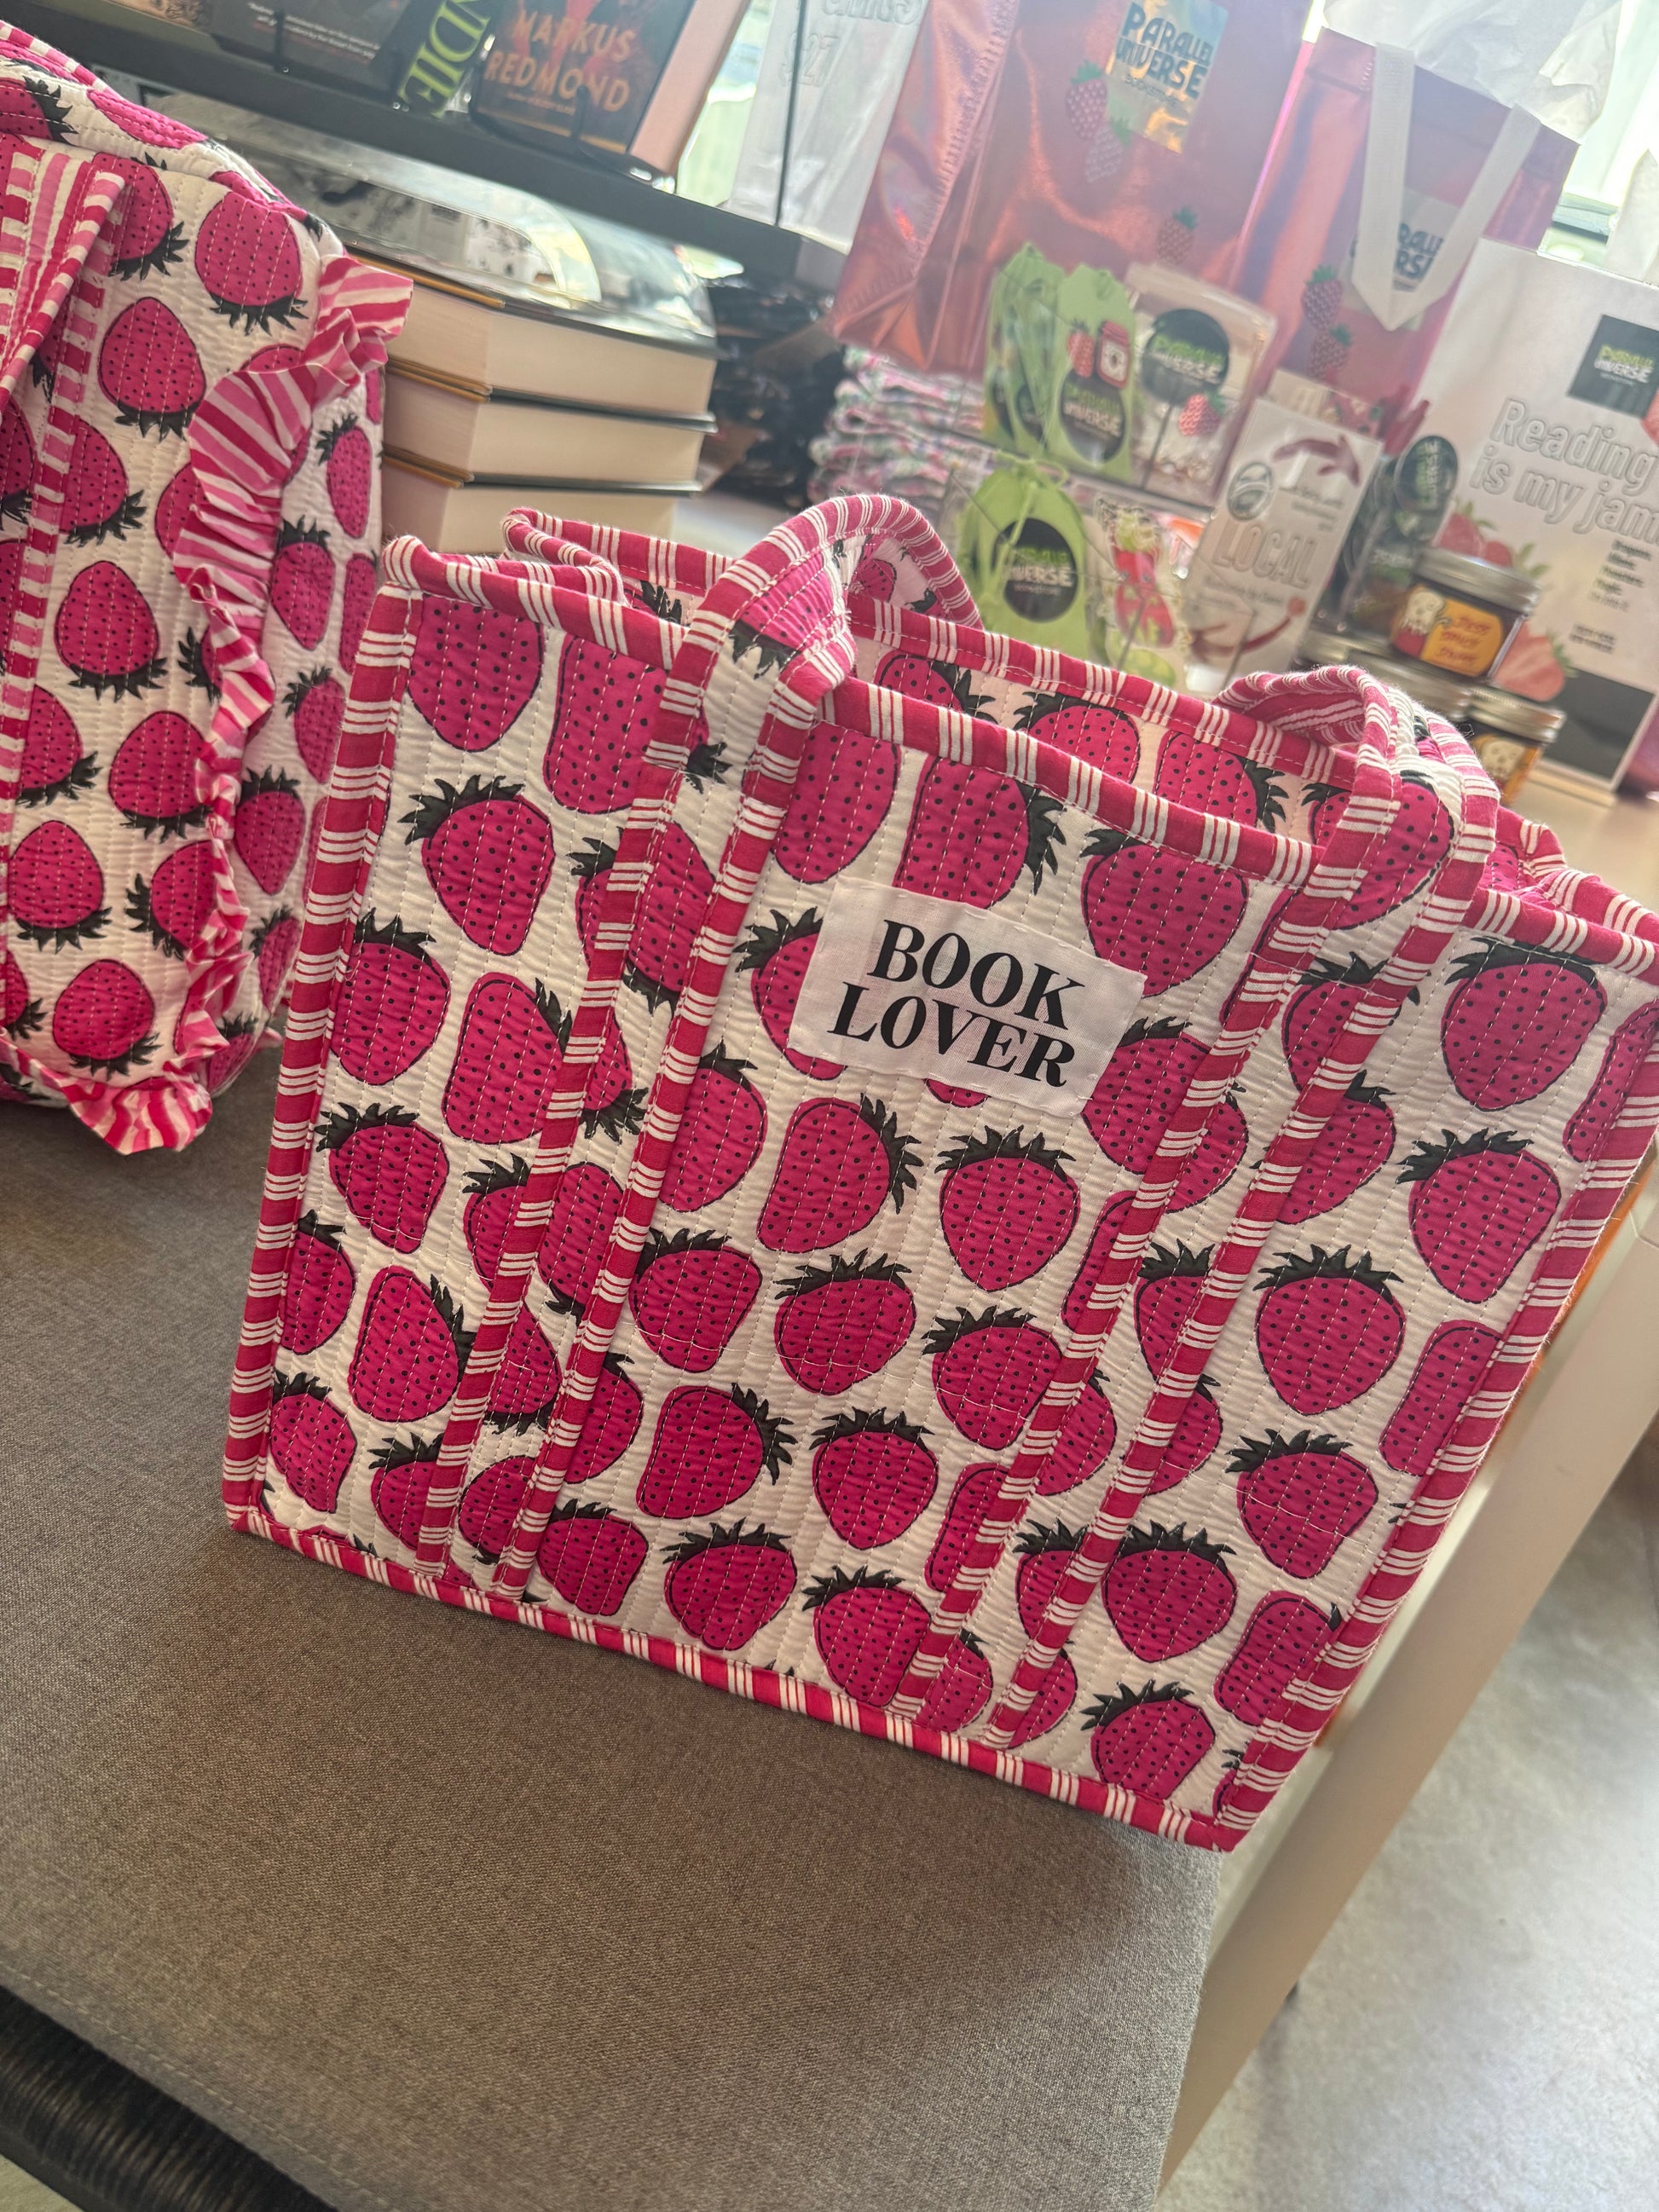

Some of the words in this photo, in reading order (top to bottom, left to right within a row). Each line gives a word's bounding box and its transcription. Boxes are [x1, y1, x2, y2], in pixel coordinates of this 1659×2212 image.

[483, 50, 631, 113] REDMOND
[512, 9, 636, 63] MARKUS
[1468, 444, 1512, 495] is
[1512, 471, 1587, 525] my
[1490, 396, 1659, 497] Reading
[867, 919, 1085, 1030] BOOK
[827, 981, 1075, 1087] LOVER
